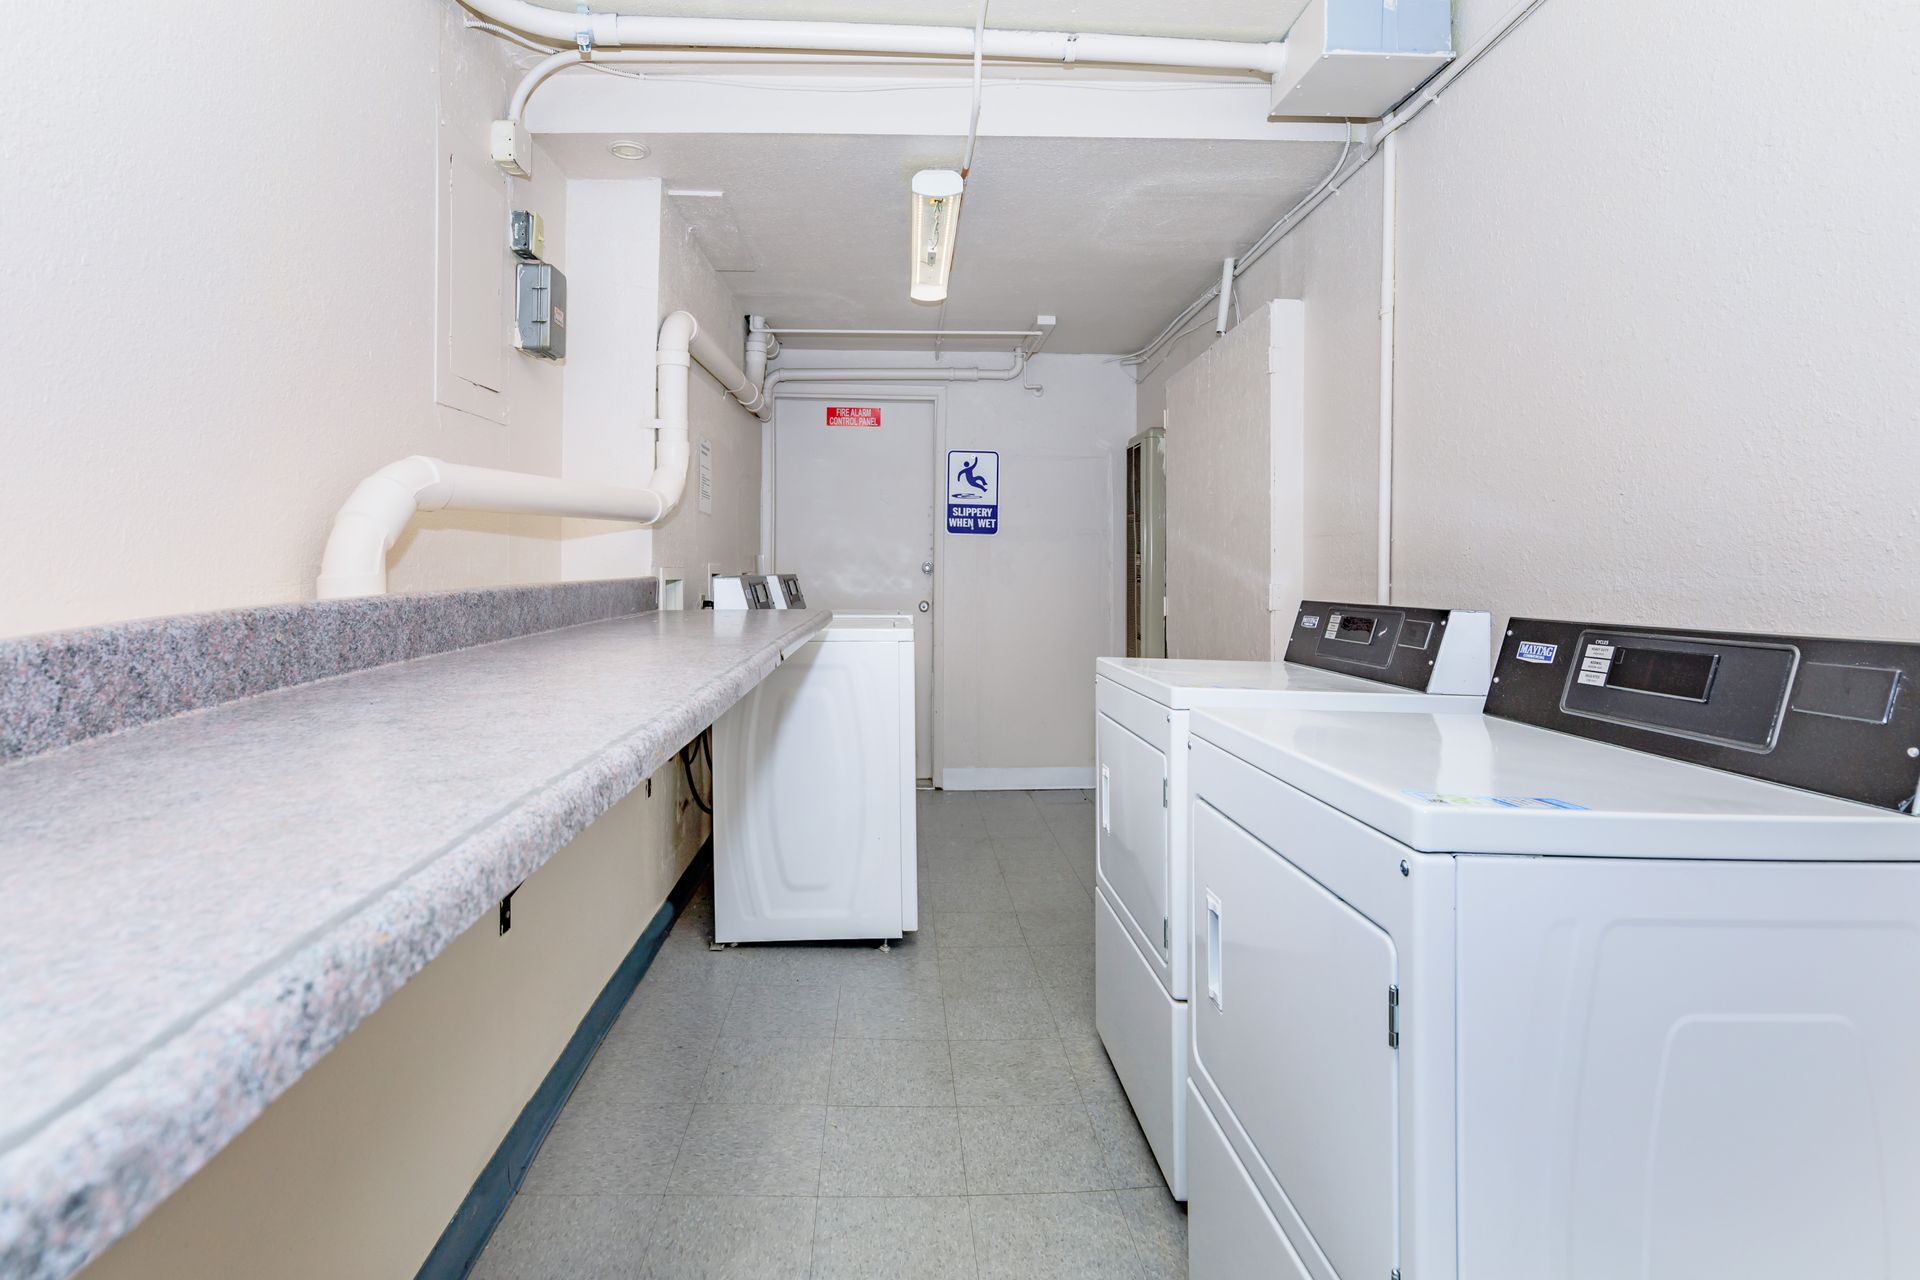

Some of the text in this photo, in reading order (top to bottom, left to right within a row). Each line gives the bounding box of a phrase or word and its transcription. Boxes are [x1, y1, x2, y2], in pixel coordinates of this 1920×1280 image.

[836, 408, 872, 417] FIRE ALARM
[829, 416, 879, 426] CONTROL PANEL
[952, 507, 993, 517] SLIPPERY
[948, 517, 997, 529] WHEN WET
[1519, 643, 1554, 657] MAYTAG
